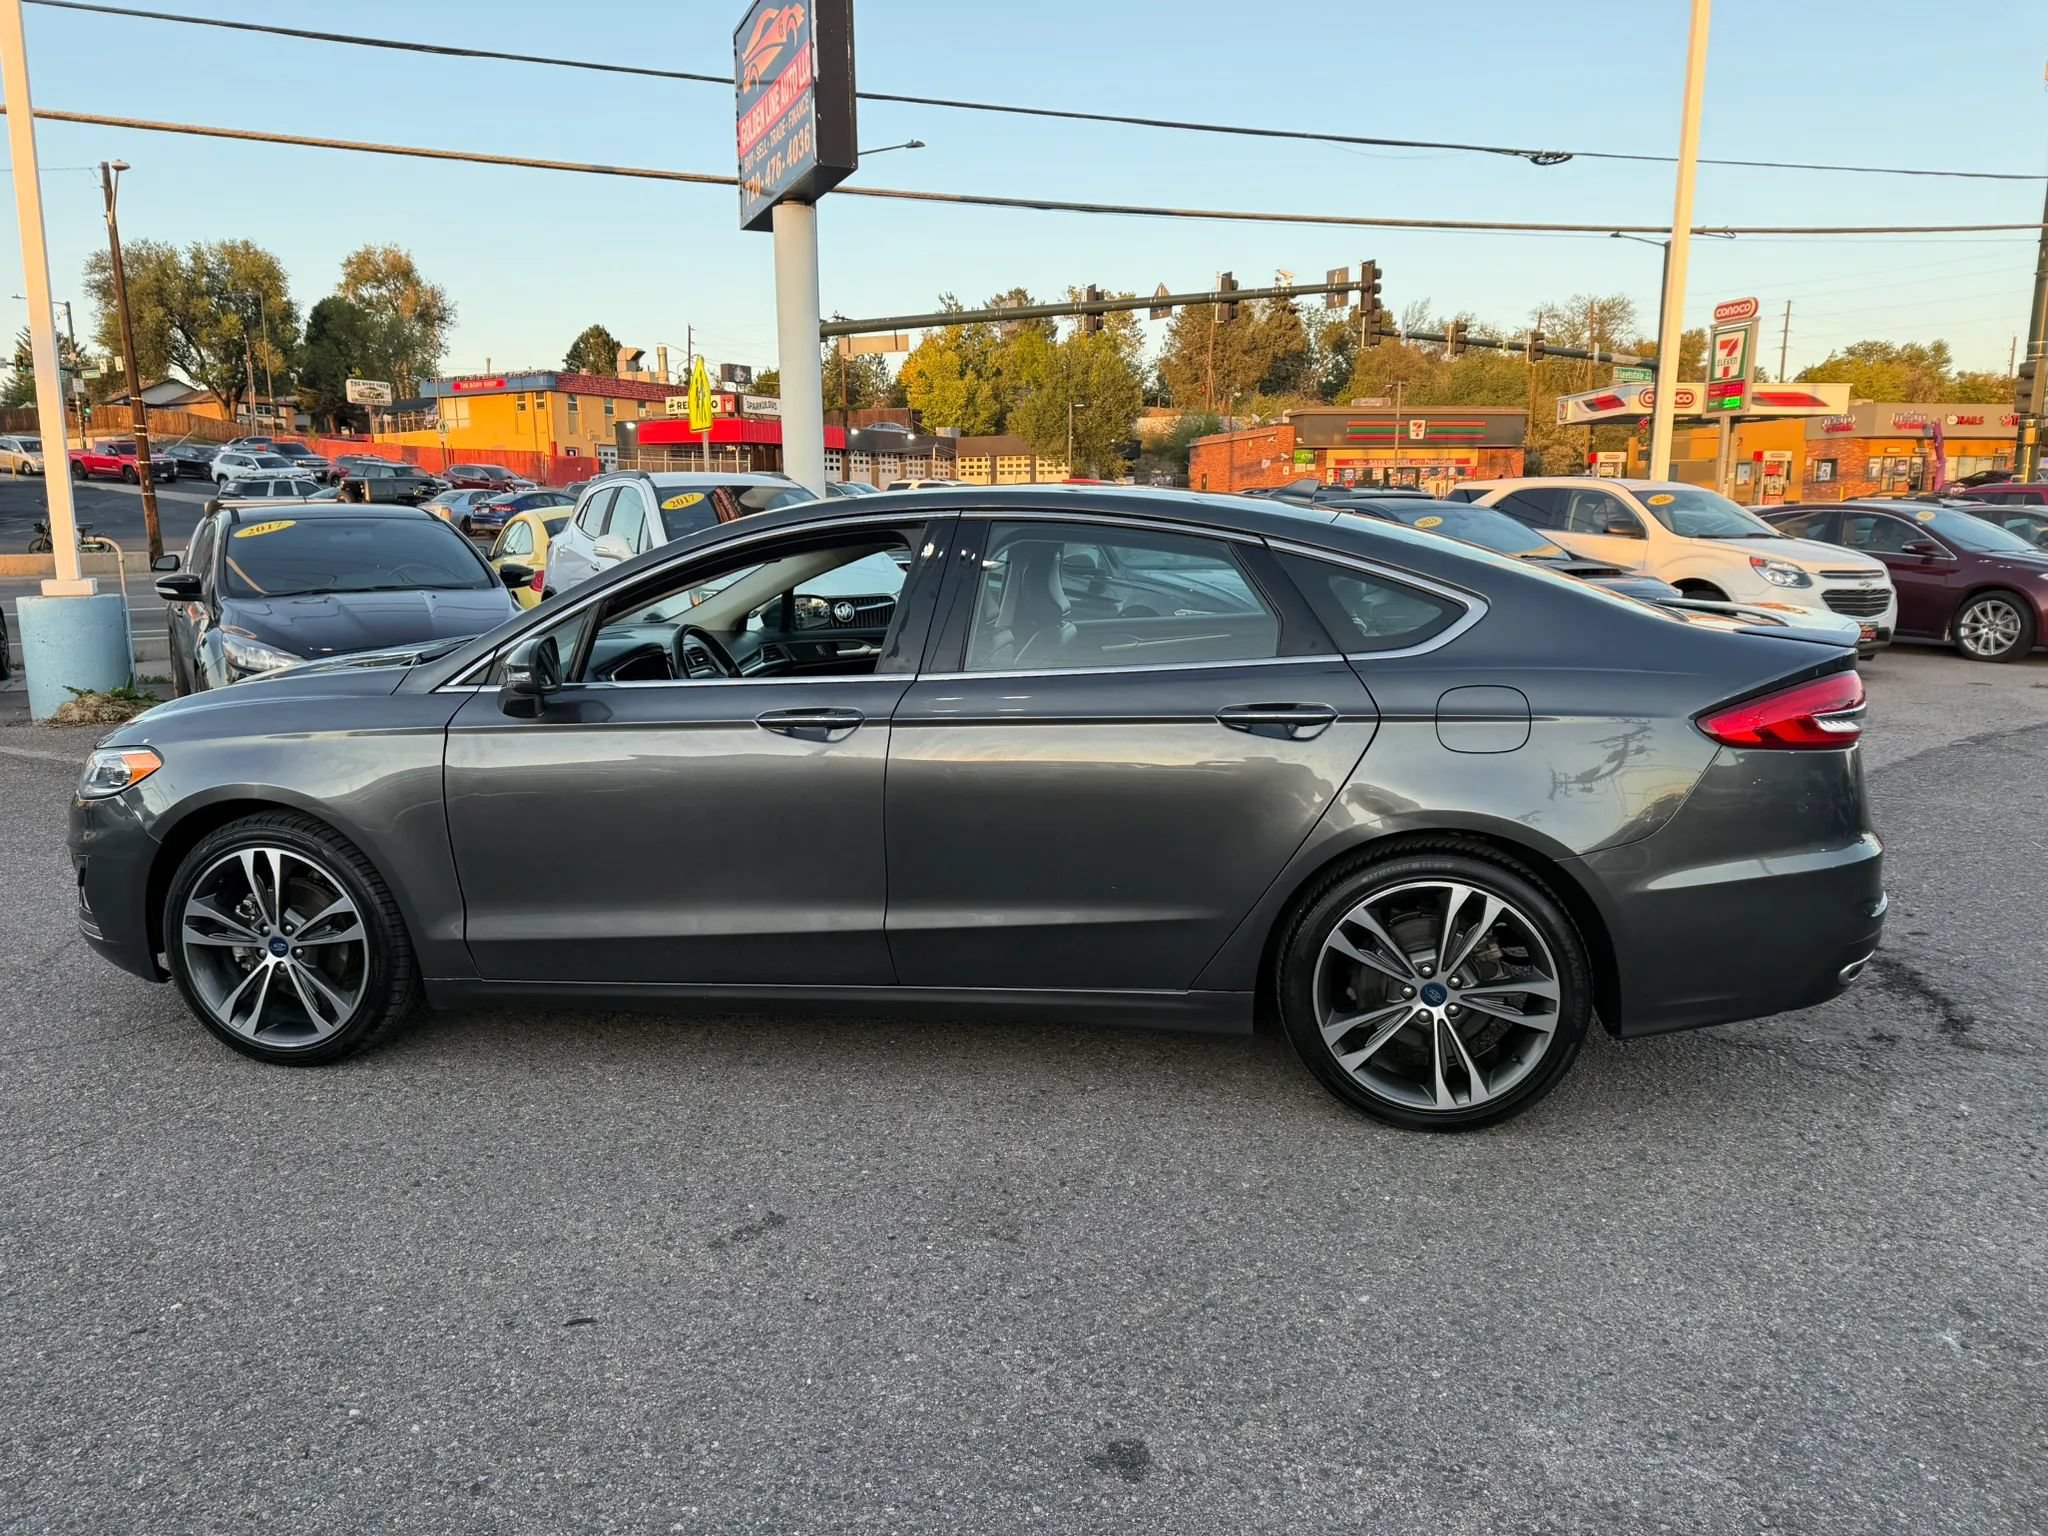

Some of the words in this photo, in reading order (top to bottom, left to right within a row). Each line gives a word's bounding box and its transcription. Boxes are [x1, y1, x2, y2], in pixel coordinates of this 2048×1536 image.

[741, 101, 765, 149] GOLDEN
[765, 82, 780, 127] LINE
[780, 62, 798, 108] AUTO
[798, 45, 812, 90] LLC
[670, 494, 696, 508] 2017
[248, 522, 282, 536] 2017
